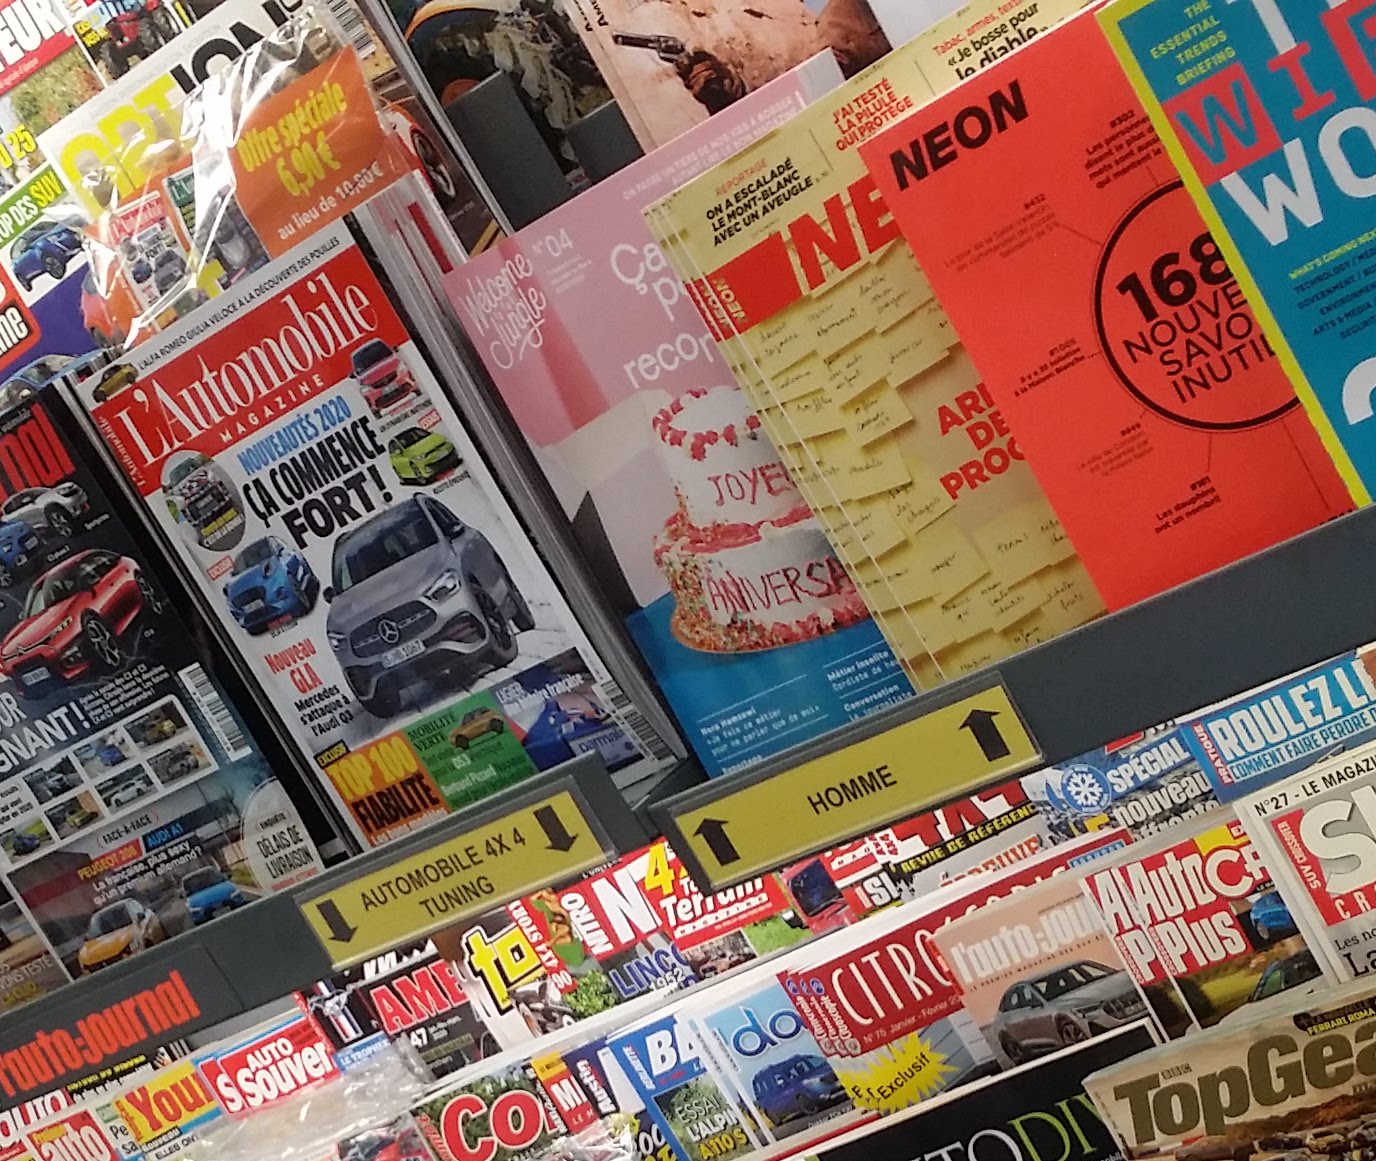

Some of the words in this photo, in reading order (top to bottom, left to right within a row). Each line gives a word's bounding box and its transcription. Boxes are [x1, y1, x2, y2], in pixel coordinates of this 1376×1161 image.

[1185, 0, 1210, 20] THE
[1150, 16, 1221, 61] ESSENTIAL
[1176, 31, 1227, 66] TRENDS
[1177, 47, 1236, 86] BRIEFING
[890, 80, 1030, 191] NEON
[707, 204, 723, 219] ON
[734, 158, 794, 200] ESCALADÉ
[712, 218, 726, 232] LE
[727, 171, 800, 221] MONT-BLANC
[713, 223, 743, 247] AVEC
[743, 213, 760, 228] UN
[762, 176, 813, 215] AVEUGLE
[1294, 262, 1351, 294] TECHNOLOGY
[1297, 276, 1355, 310] GOVERNMENT
[115, 276, 380, 465] L'Automobile
[218, 372, 325, 444] MAGAZINE
[239, 412, 319, 476] NOUVEAUTÉS
[317, 396, 353, 429] 2020
[273, 417, 387, 509] COMMENCE
[281, 477, 377, 549] FORT
[1208, 677, 1331, 762] ROULEZ
[807, 766, 898, 816] HOMME
[1301, 778, 1321, 796] LE
[359, 839, 486, 912] AUTOMOBILE
[418, 876, 495, 920] TUNING
[1335, 935, 1360, 951] Les
[875, 1052, 933, 1101] Exclusif
